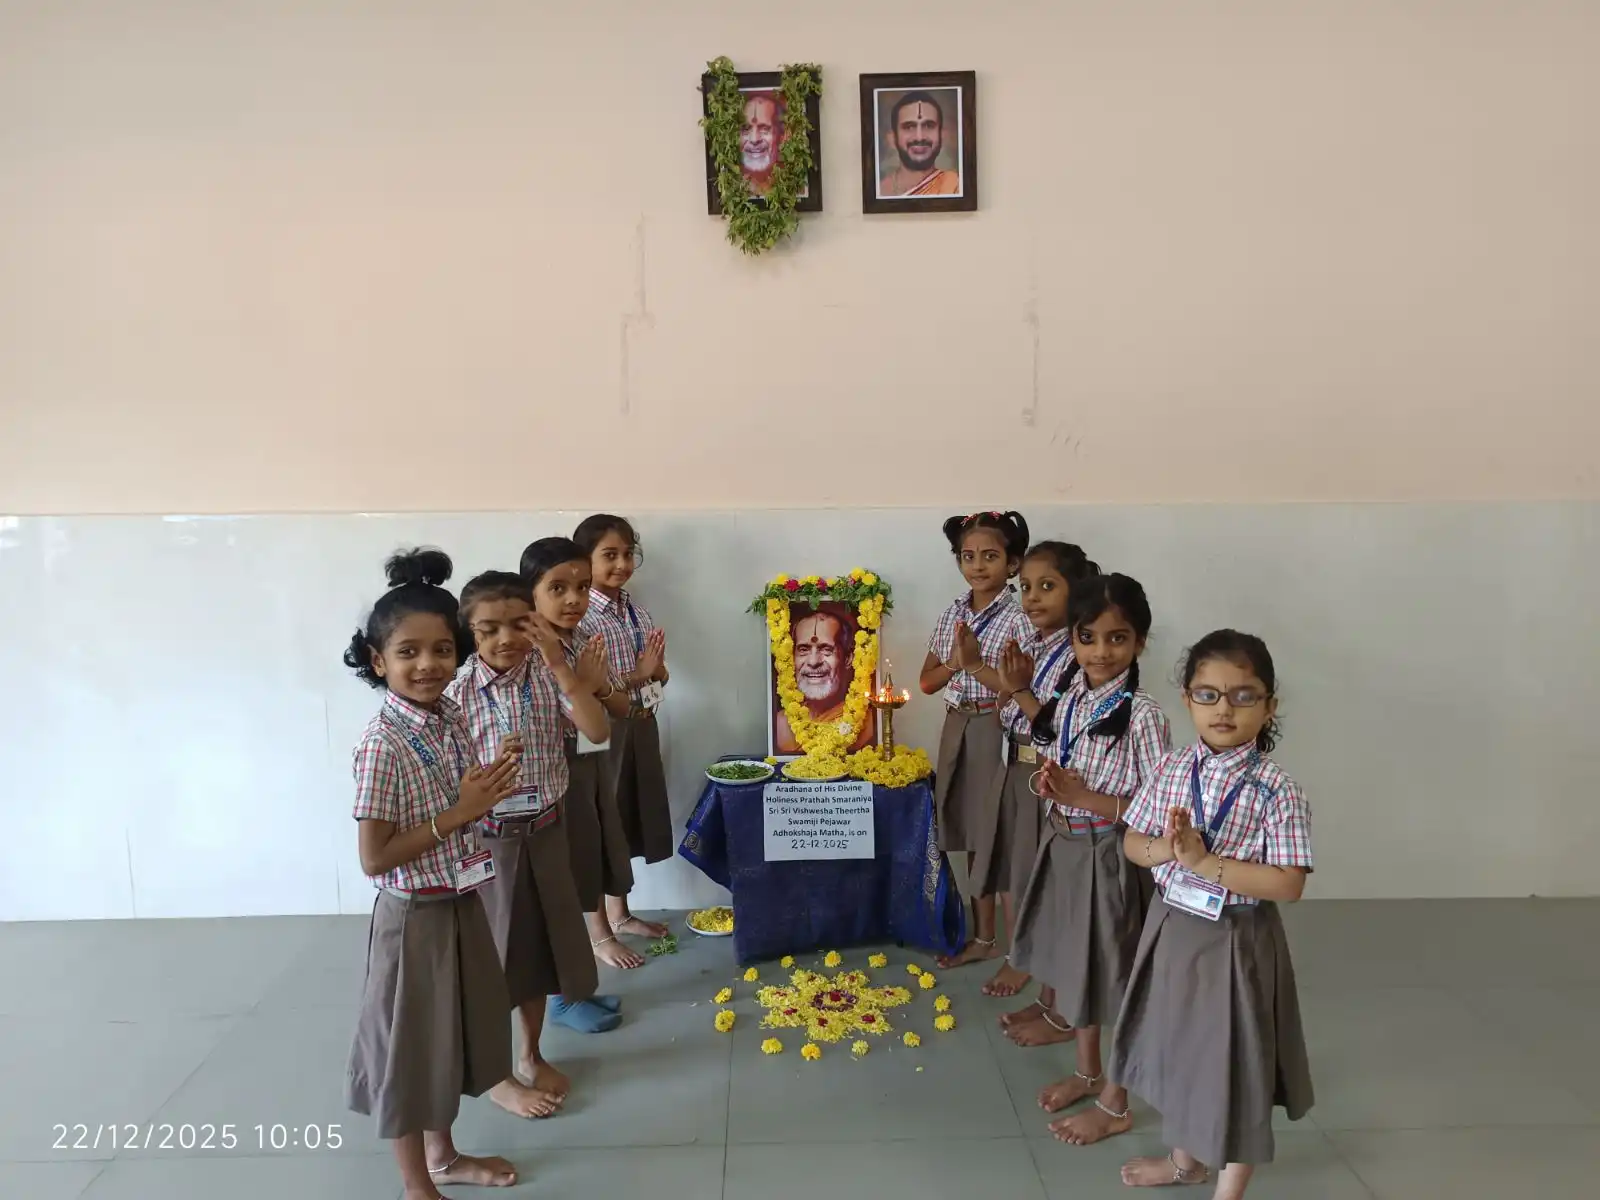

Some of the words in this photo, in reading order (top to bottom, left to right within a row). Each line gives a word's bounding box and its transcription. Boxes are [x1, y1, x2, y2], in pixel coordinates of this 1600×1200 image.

[775, 785, 812, 793] Aradhana
[838, 784, 862, 792] Divine
[766, 796, 798, 804] Holiness
[832, 795, 872, 804] Smaraniya
[793, 807, 833, 815] Vishwesha
[788, 818, 818, 827] Swamiji
[820, 818, 851, 827] Pejawar
[773, 829, 818, 838] Adhokshaja
[819, 829, 847, 837] Matha,
